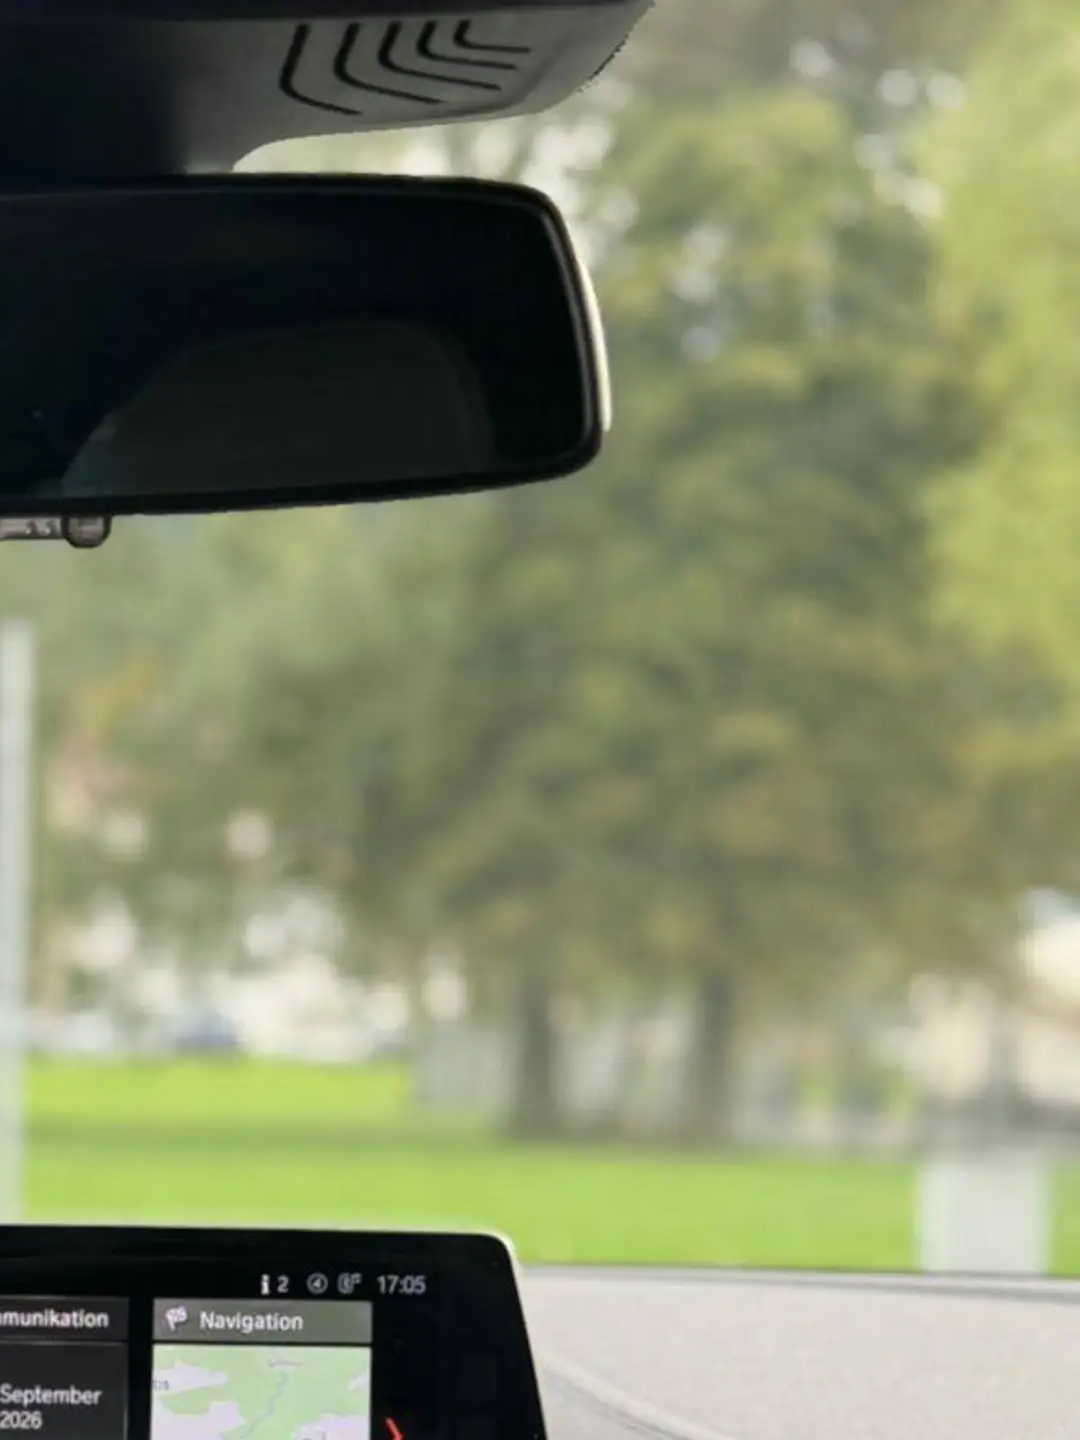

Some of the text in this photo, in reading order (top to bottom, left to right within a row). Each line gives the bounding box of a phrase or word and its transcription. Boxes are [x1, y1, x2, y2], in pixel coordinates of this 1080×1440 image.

[277, 1278, 289, 1292] 2
[377, 1275, 427, 1295] 17:05
[199, 1311, 304, 1334] Navigation
[0, 1383, 102, 1406] September
